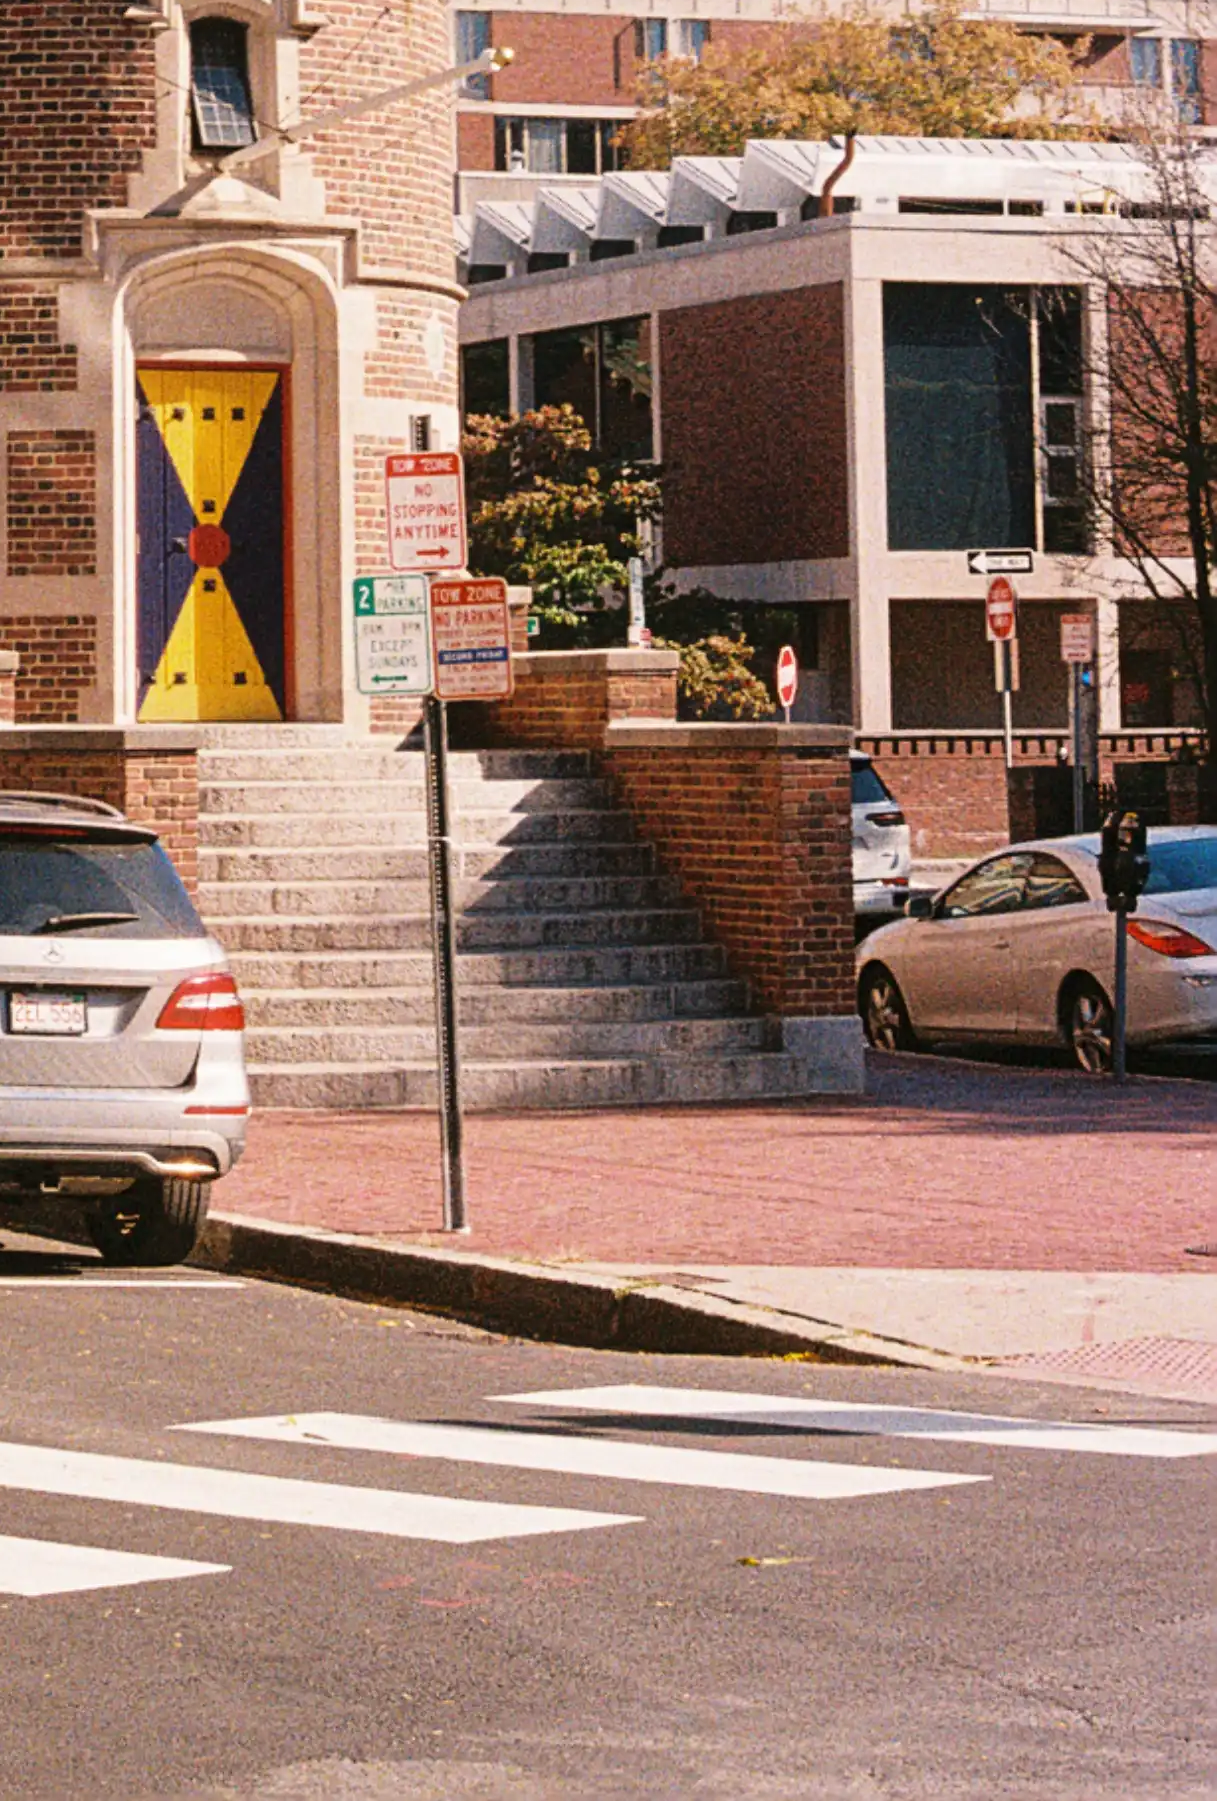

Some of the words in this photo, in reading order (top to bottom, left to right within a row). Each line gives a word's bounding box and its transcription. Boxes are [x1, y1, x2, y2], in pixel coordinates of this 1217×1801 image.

[420, 457, 454, 472] ZONE
[414, 483, 433, 498] NO
[393, 502, 457, 519] STOPPING
[394, 522, 459, 539] ANYTIME
[358, 585, 371, 610] 2
[433, 587, 461, 604] TOW
[465, 585, 504, 602] ZONE
[455, 608, 504, 626] PARKING
